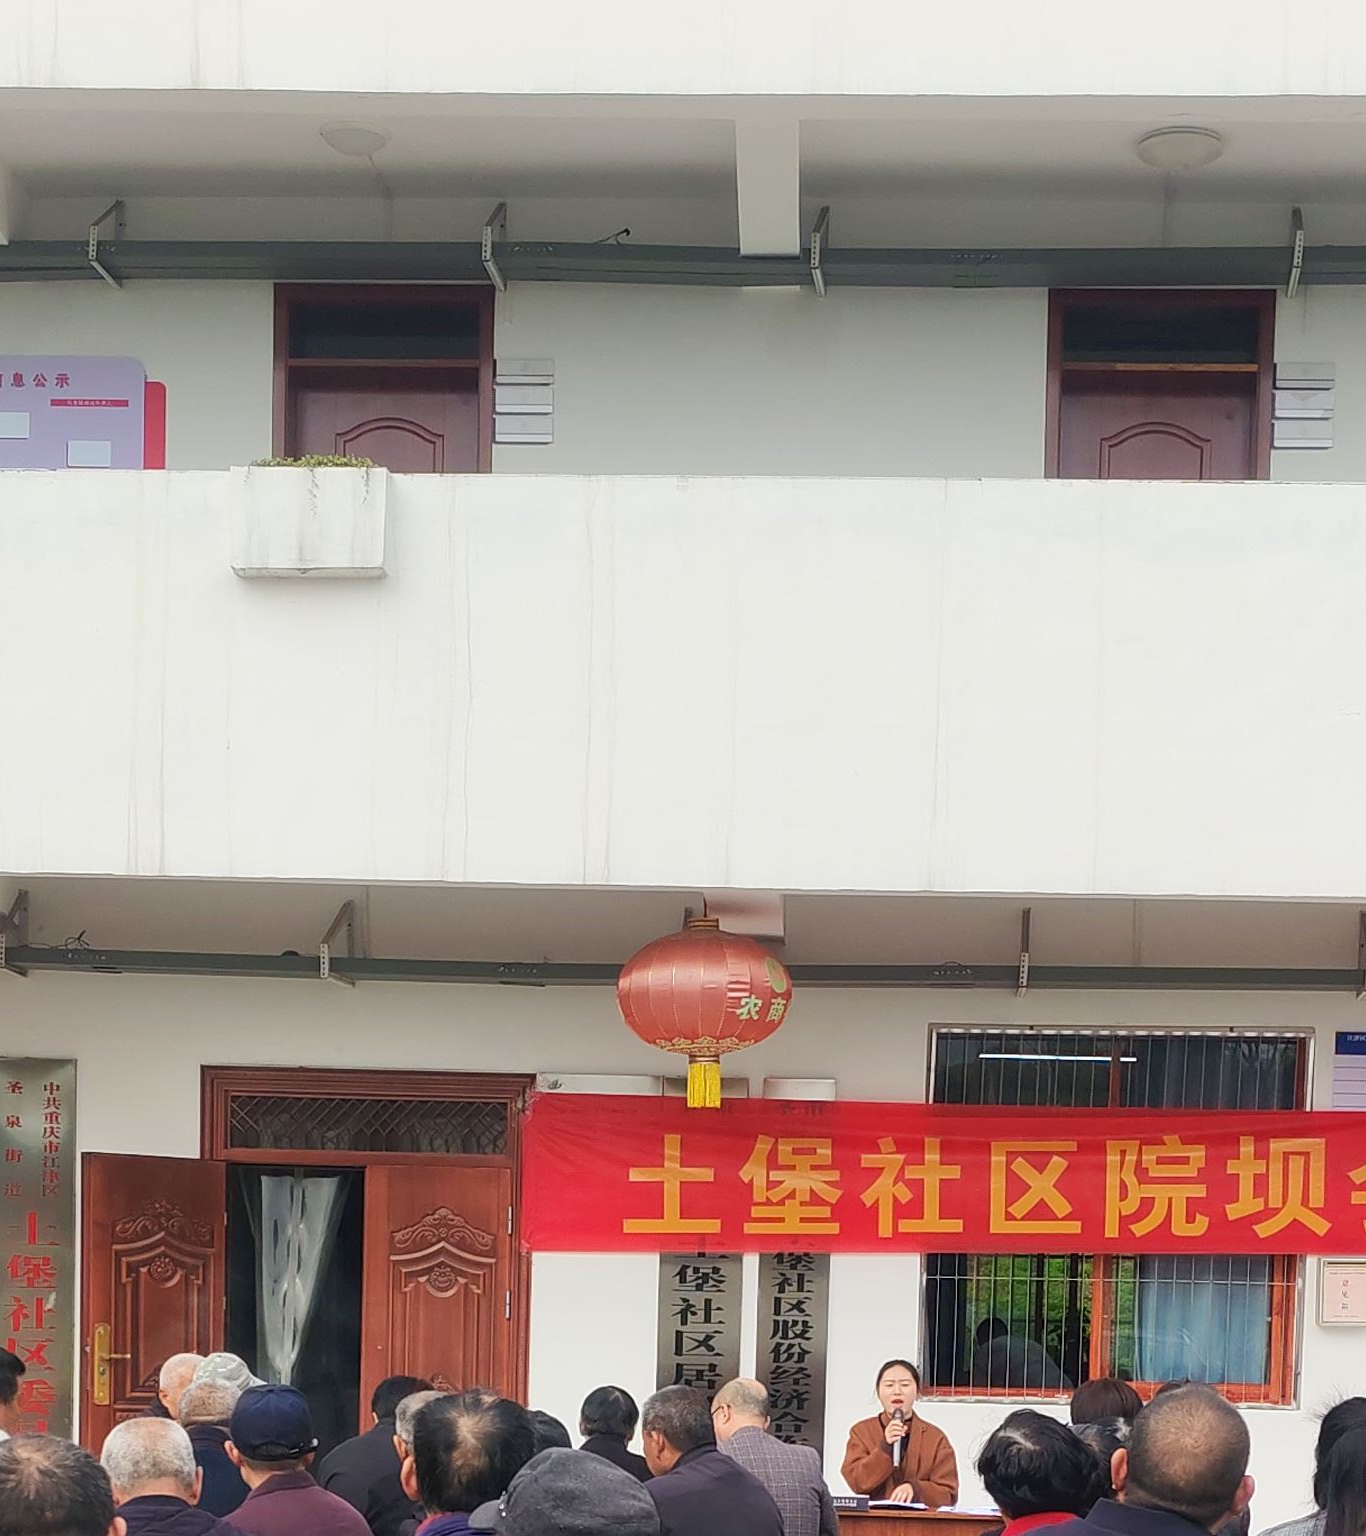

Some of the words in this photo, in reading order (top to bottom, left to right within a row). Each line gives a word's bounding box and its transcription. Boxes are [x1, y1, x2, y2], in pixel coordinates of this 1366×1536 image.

[3, 1081, 24, 1198] 圣泉街道
[41, 1081, 62, 1198] 中共重庆市江津区
